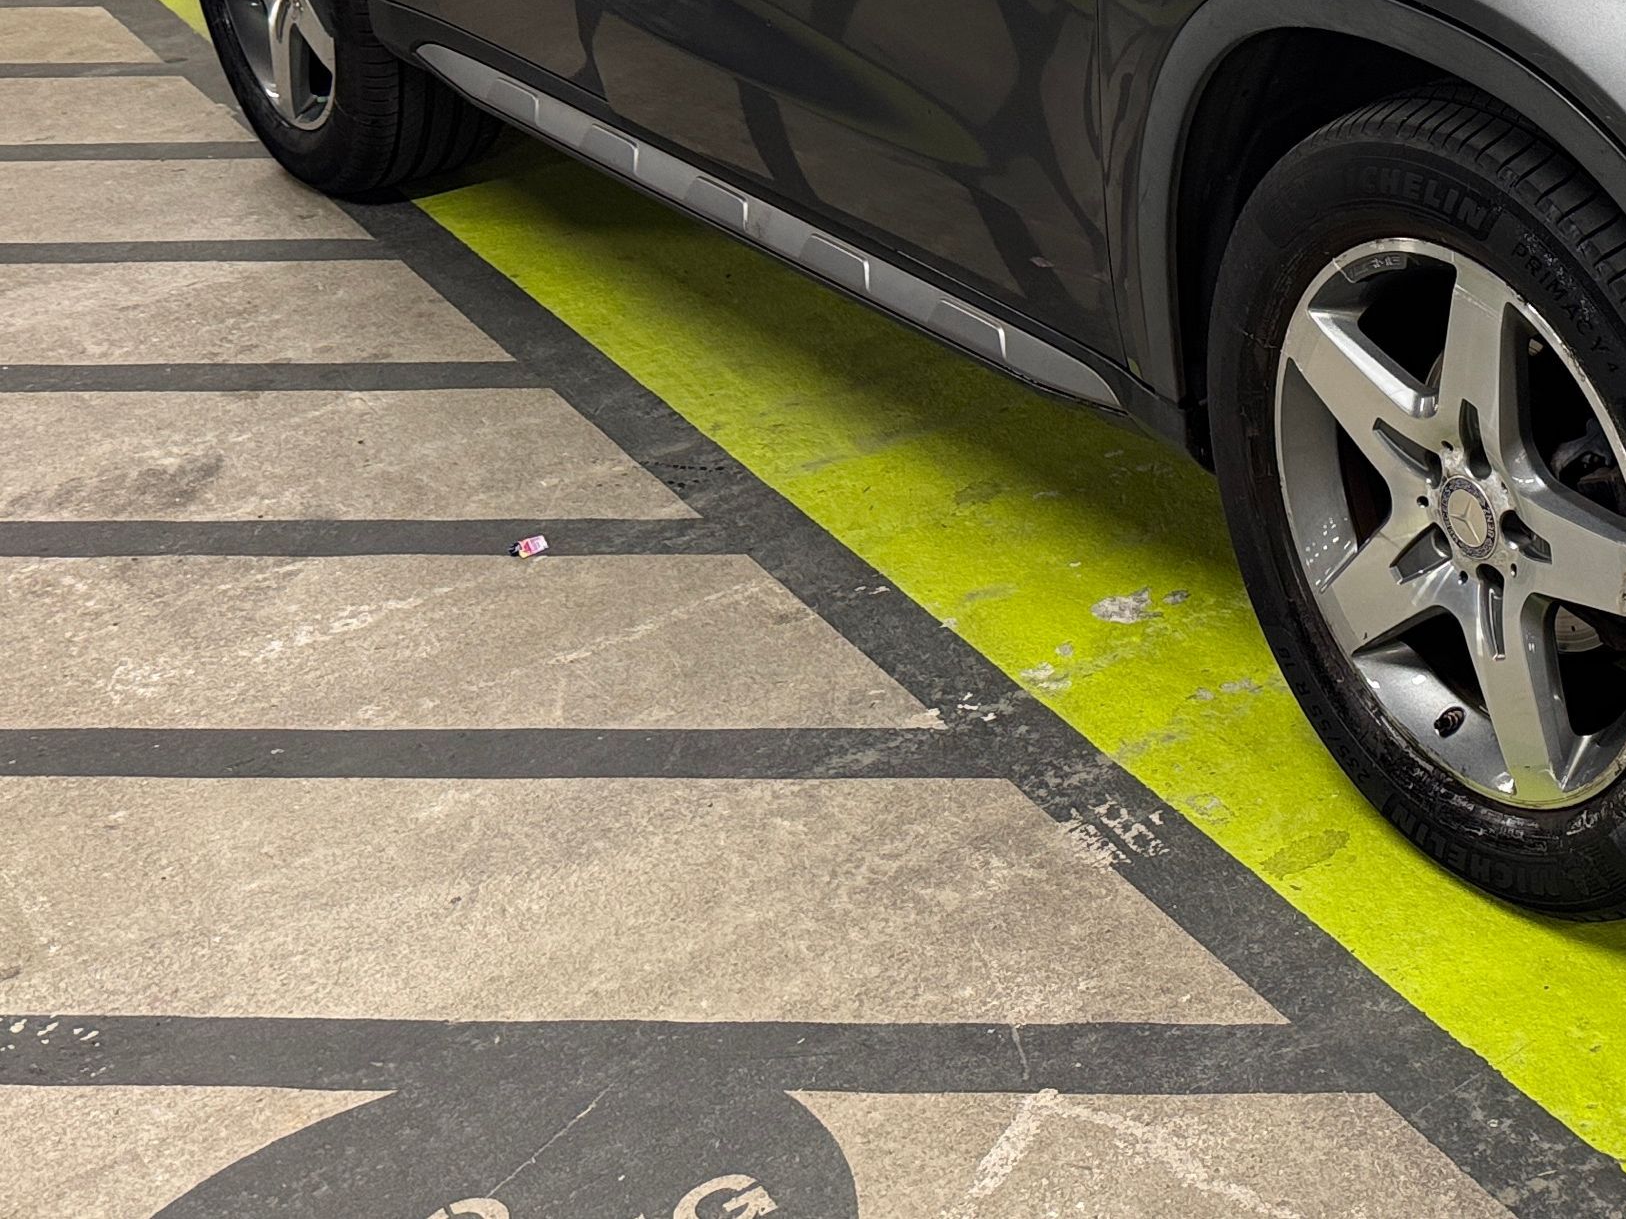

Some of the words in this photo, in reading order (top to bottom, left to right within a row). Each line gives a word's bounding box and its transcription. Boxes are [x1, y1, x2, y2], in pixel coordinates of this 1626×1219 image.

[1511, 242, 1610, 353] PRIMACY
[1295, 681, 1311, 697] R
[1311, 704, 1371, 783] 235/55
